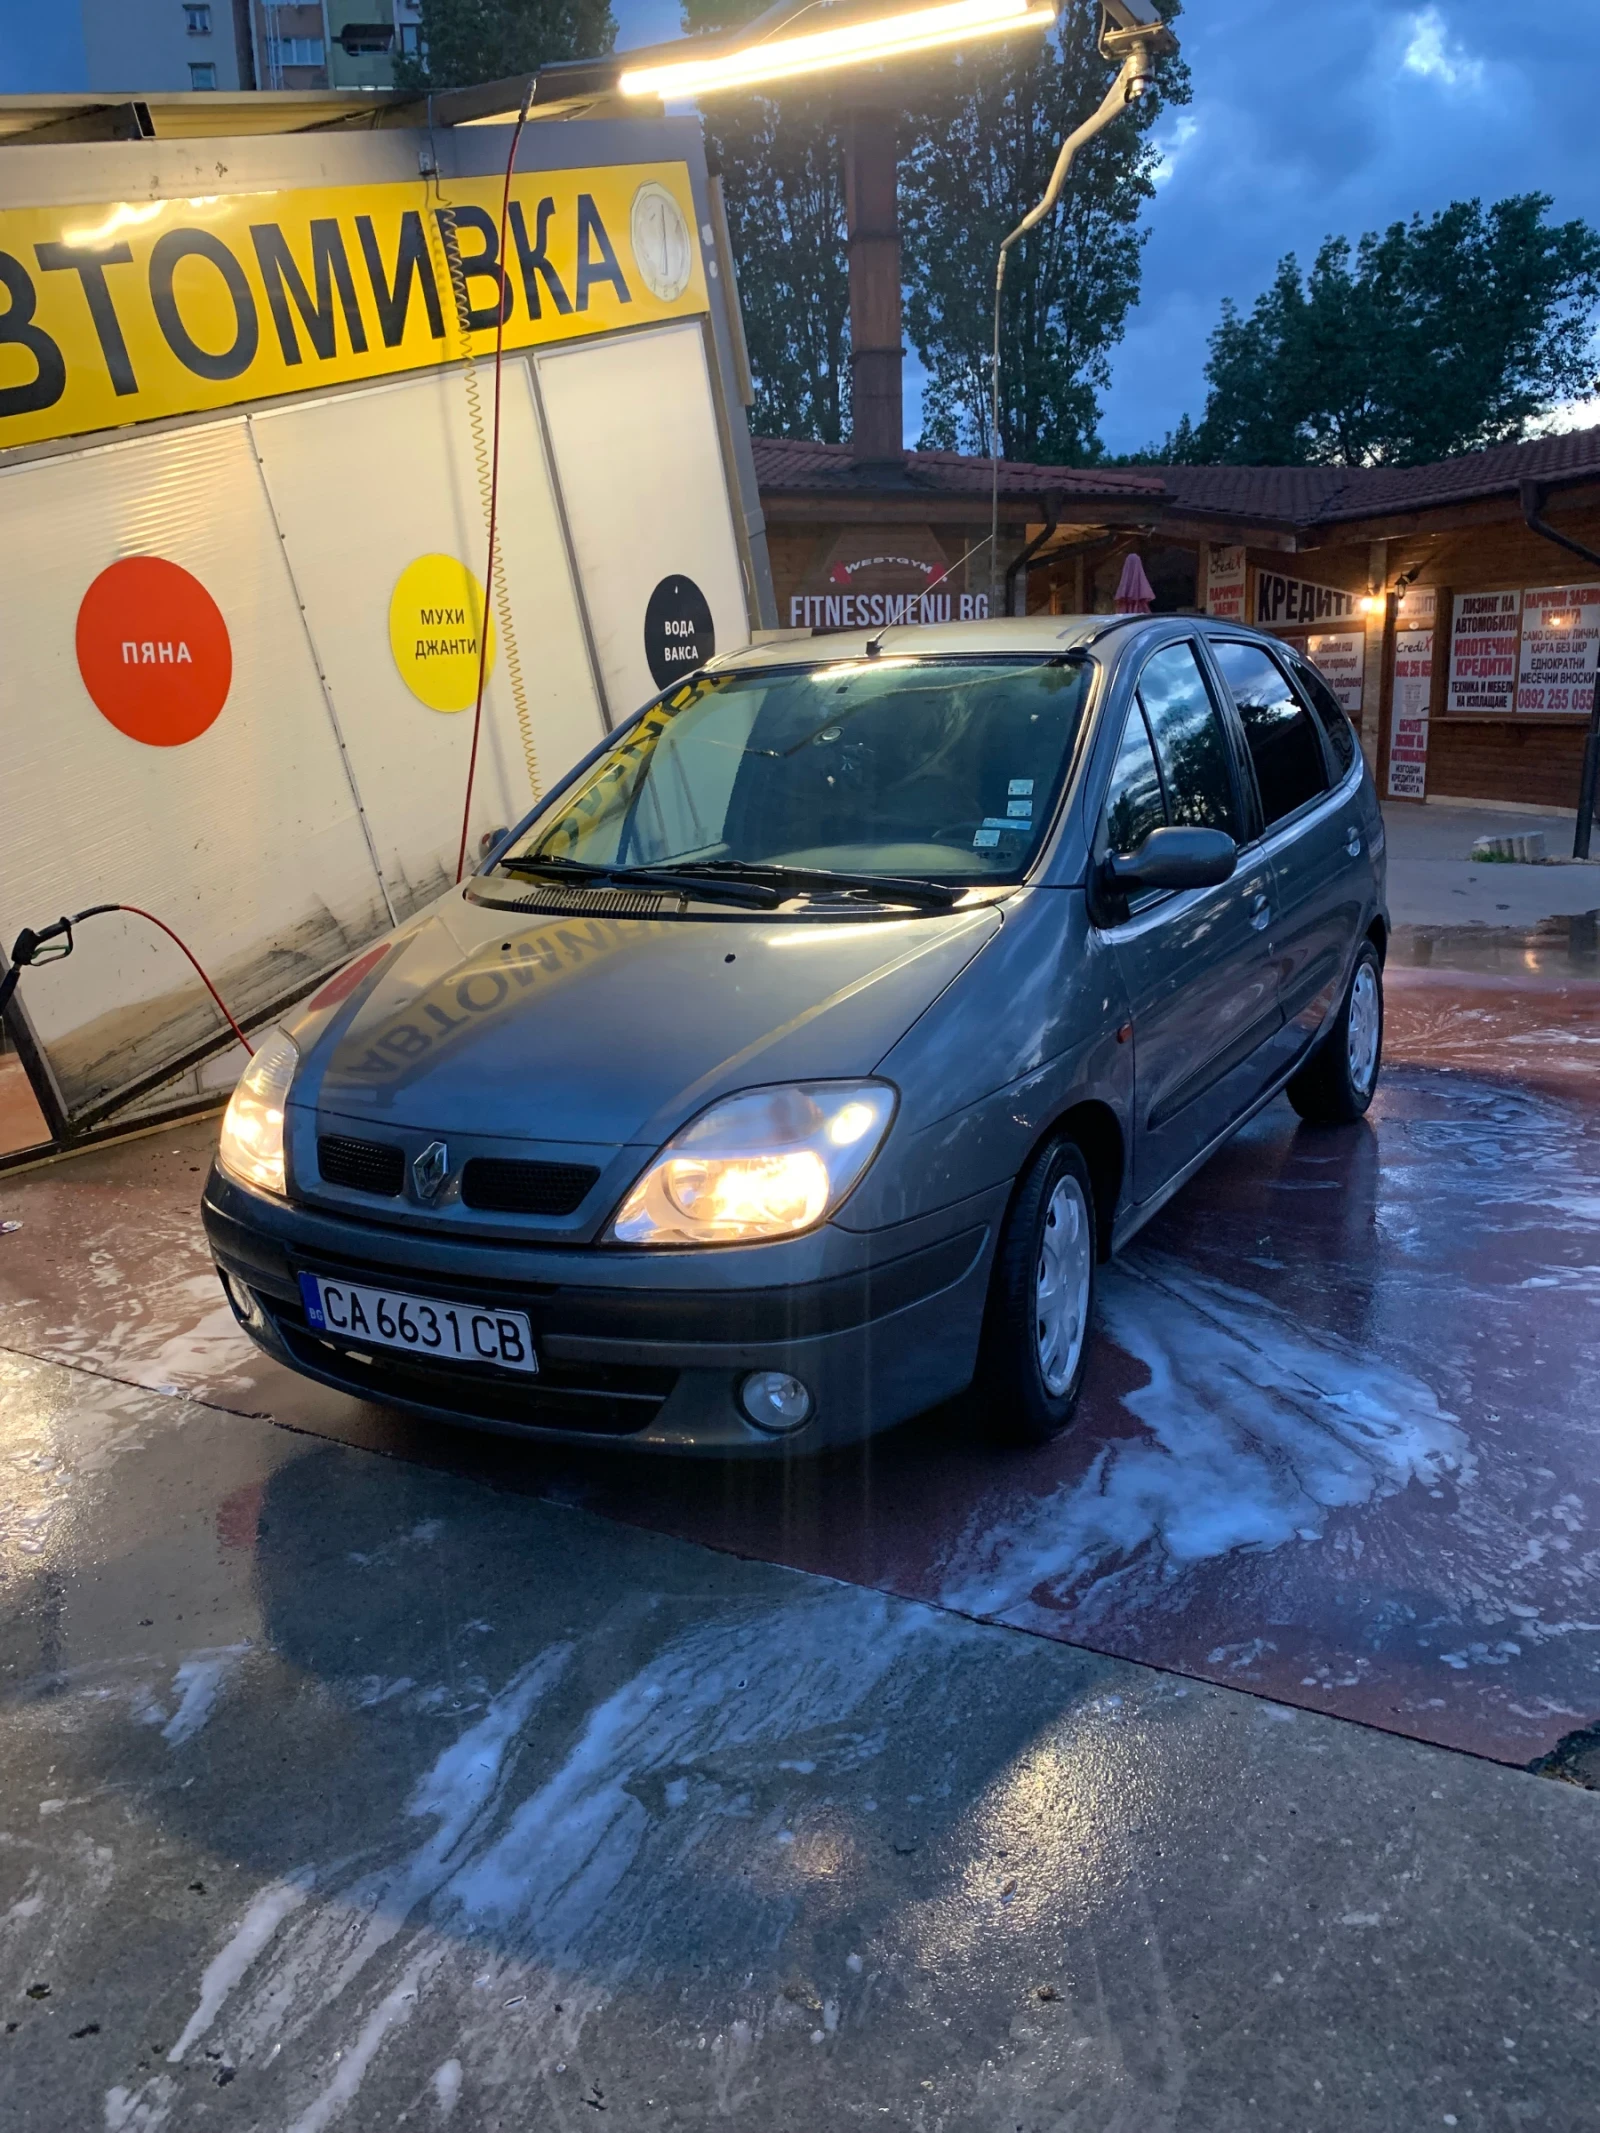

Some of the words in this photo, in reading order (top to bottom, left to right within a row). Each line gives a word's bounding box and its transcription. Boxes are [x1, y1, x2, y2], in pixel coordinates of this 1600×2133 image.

[844, 556, 933, 575] WESTGYM
[1462, 597, 1499, 614] ЛИЗИНГ
[1501, 595, 1515, 611] НА
[420, 608, 466, 626] МУХИ
[664, 620, 695, 637] ВОДА
[1522, 630, 1543, 641] САМО
[1572, 628, 1599, 640] ЛИЧНА
[122, 641, 193, 664] ПЯНА
[415, 638, 477, 660] ДЖАНТИ
[1396, 636, 1433, 653] CrediX
[1531, 642, 1554, 654] КАРТА
[1555, 642, 1571, 654] БЕЗ
[1572, 641, 1588, 654] ЦКР
[664, 646, 699, 662] ВАКСА
[1456, 657, 1513, 678] КРЕДИТИ
[1531, 657, 1585, 671] ЕДНОКРАТНИ
[1520, 672, 1559, 685] МЕСЕЧНИ
[1560, 671, 1595, 684] ВНОСКИ
[1480, 681, 1486, 693] И
[1457, 694, 1465, 707] НА
[1518, 688, 1545, 709] 0892
[1546, 688, 1569, 710] 255
[1571, 688, 1594, 710] 055
[1416, 775, 1424, 784] НА
[309, 1307, 323, 1321] BG
